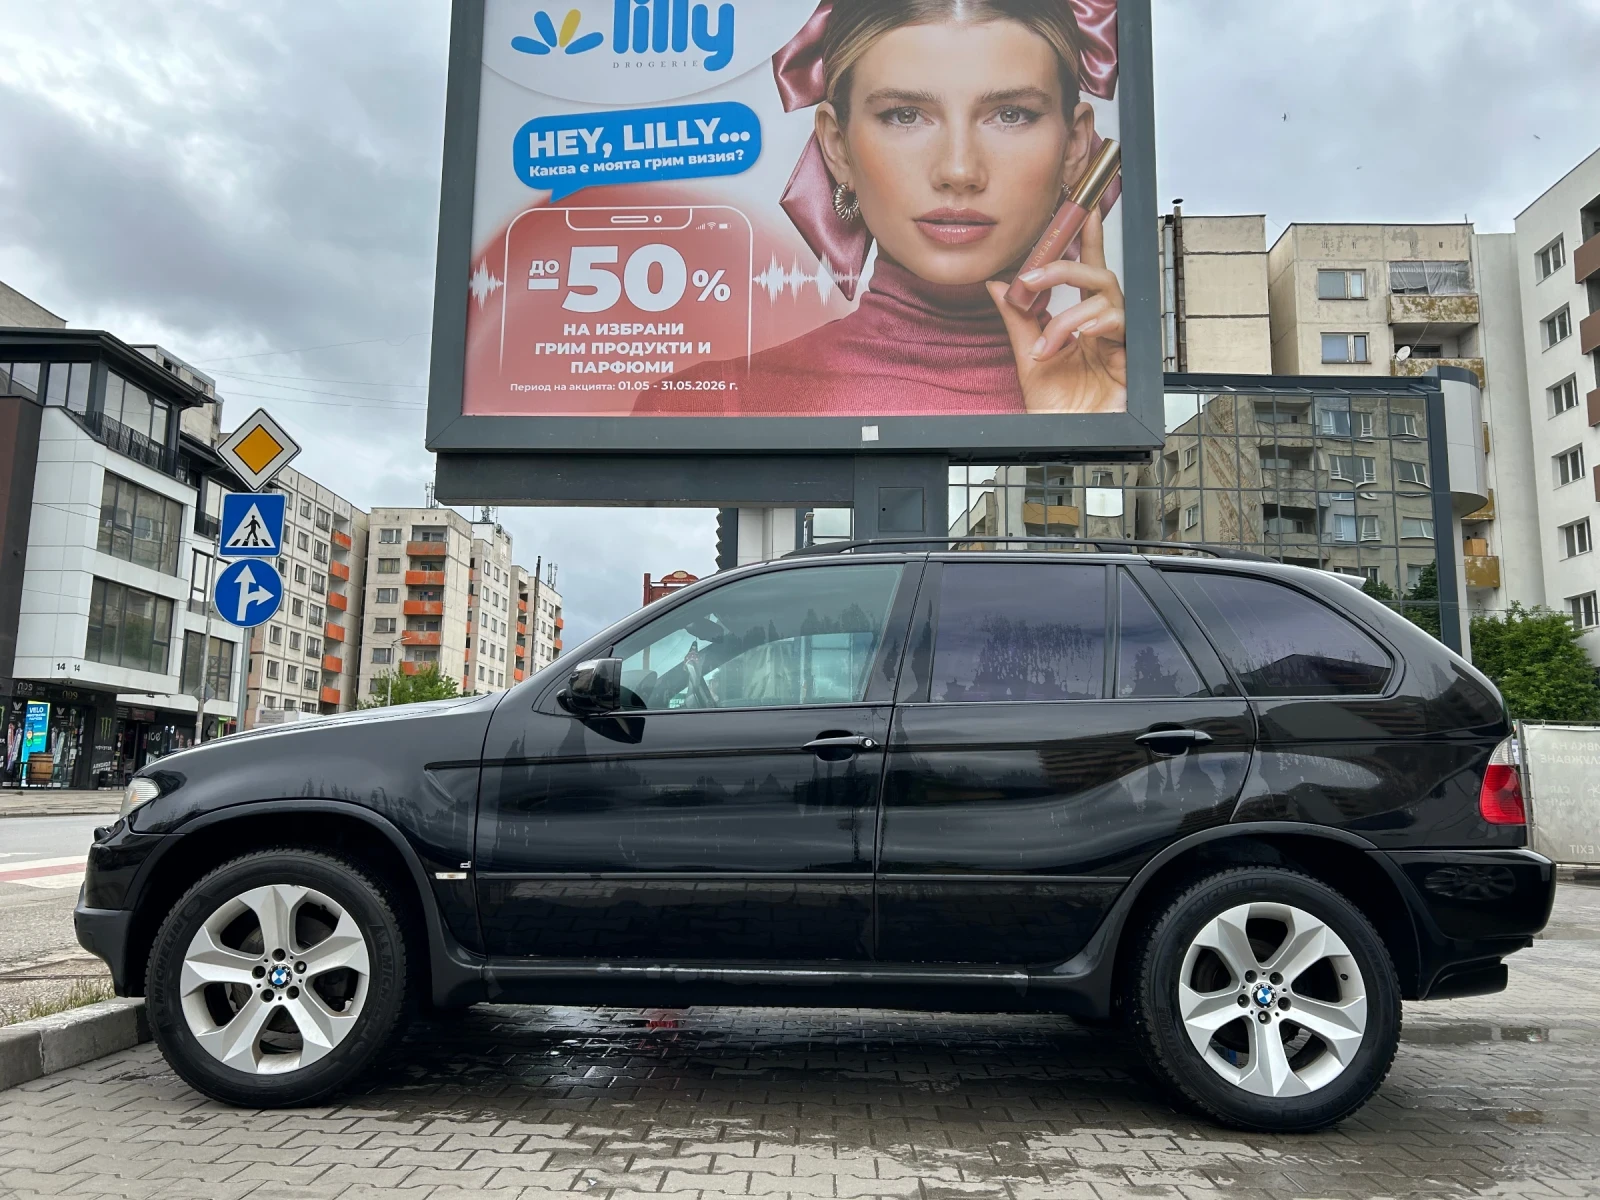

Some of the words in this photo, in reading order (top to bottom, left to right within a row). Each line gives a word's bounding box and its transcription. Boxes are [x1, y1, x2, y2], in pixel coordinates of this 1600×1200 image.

[612, 0, 735, 72] lilly
[612, 60, 699, 69] DROGERIE
[529, 126, 613, 159] HEY,
[623, 117, 750, 151] LILLY...
[529, 164, 577, 178] Каква
[579, 163, 589, 174] е
[593, 158, 640, 172] моята
[644, 155, 684, 170] грим
[688, 149, 744, 165] визия?
[563, 323, 591, 336] НА
[595, 322, 684, 336] ИЗБРАНИ
[535, 342, 586, 355] ГРИМ
[591, 341, 692, 356] ПРОДУКТИ
[698, 341, 711, 354] И
[570, 360, 674, 374] ПАРФЮМИ
[510, 383, 551, 393] Период
[569, 384, 615, 392] акцията:
[617, 381, 650, 391] 01.05
[661, 380, 726, 391] 31.05.2026
[729, 382, 738, 391] г.
[57, 663, 66, 671] 14
[74, 664, 81, 672] 14
[154, 916, 187, 1005] MICHELIN
